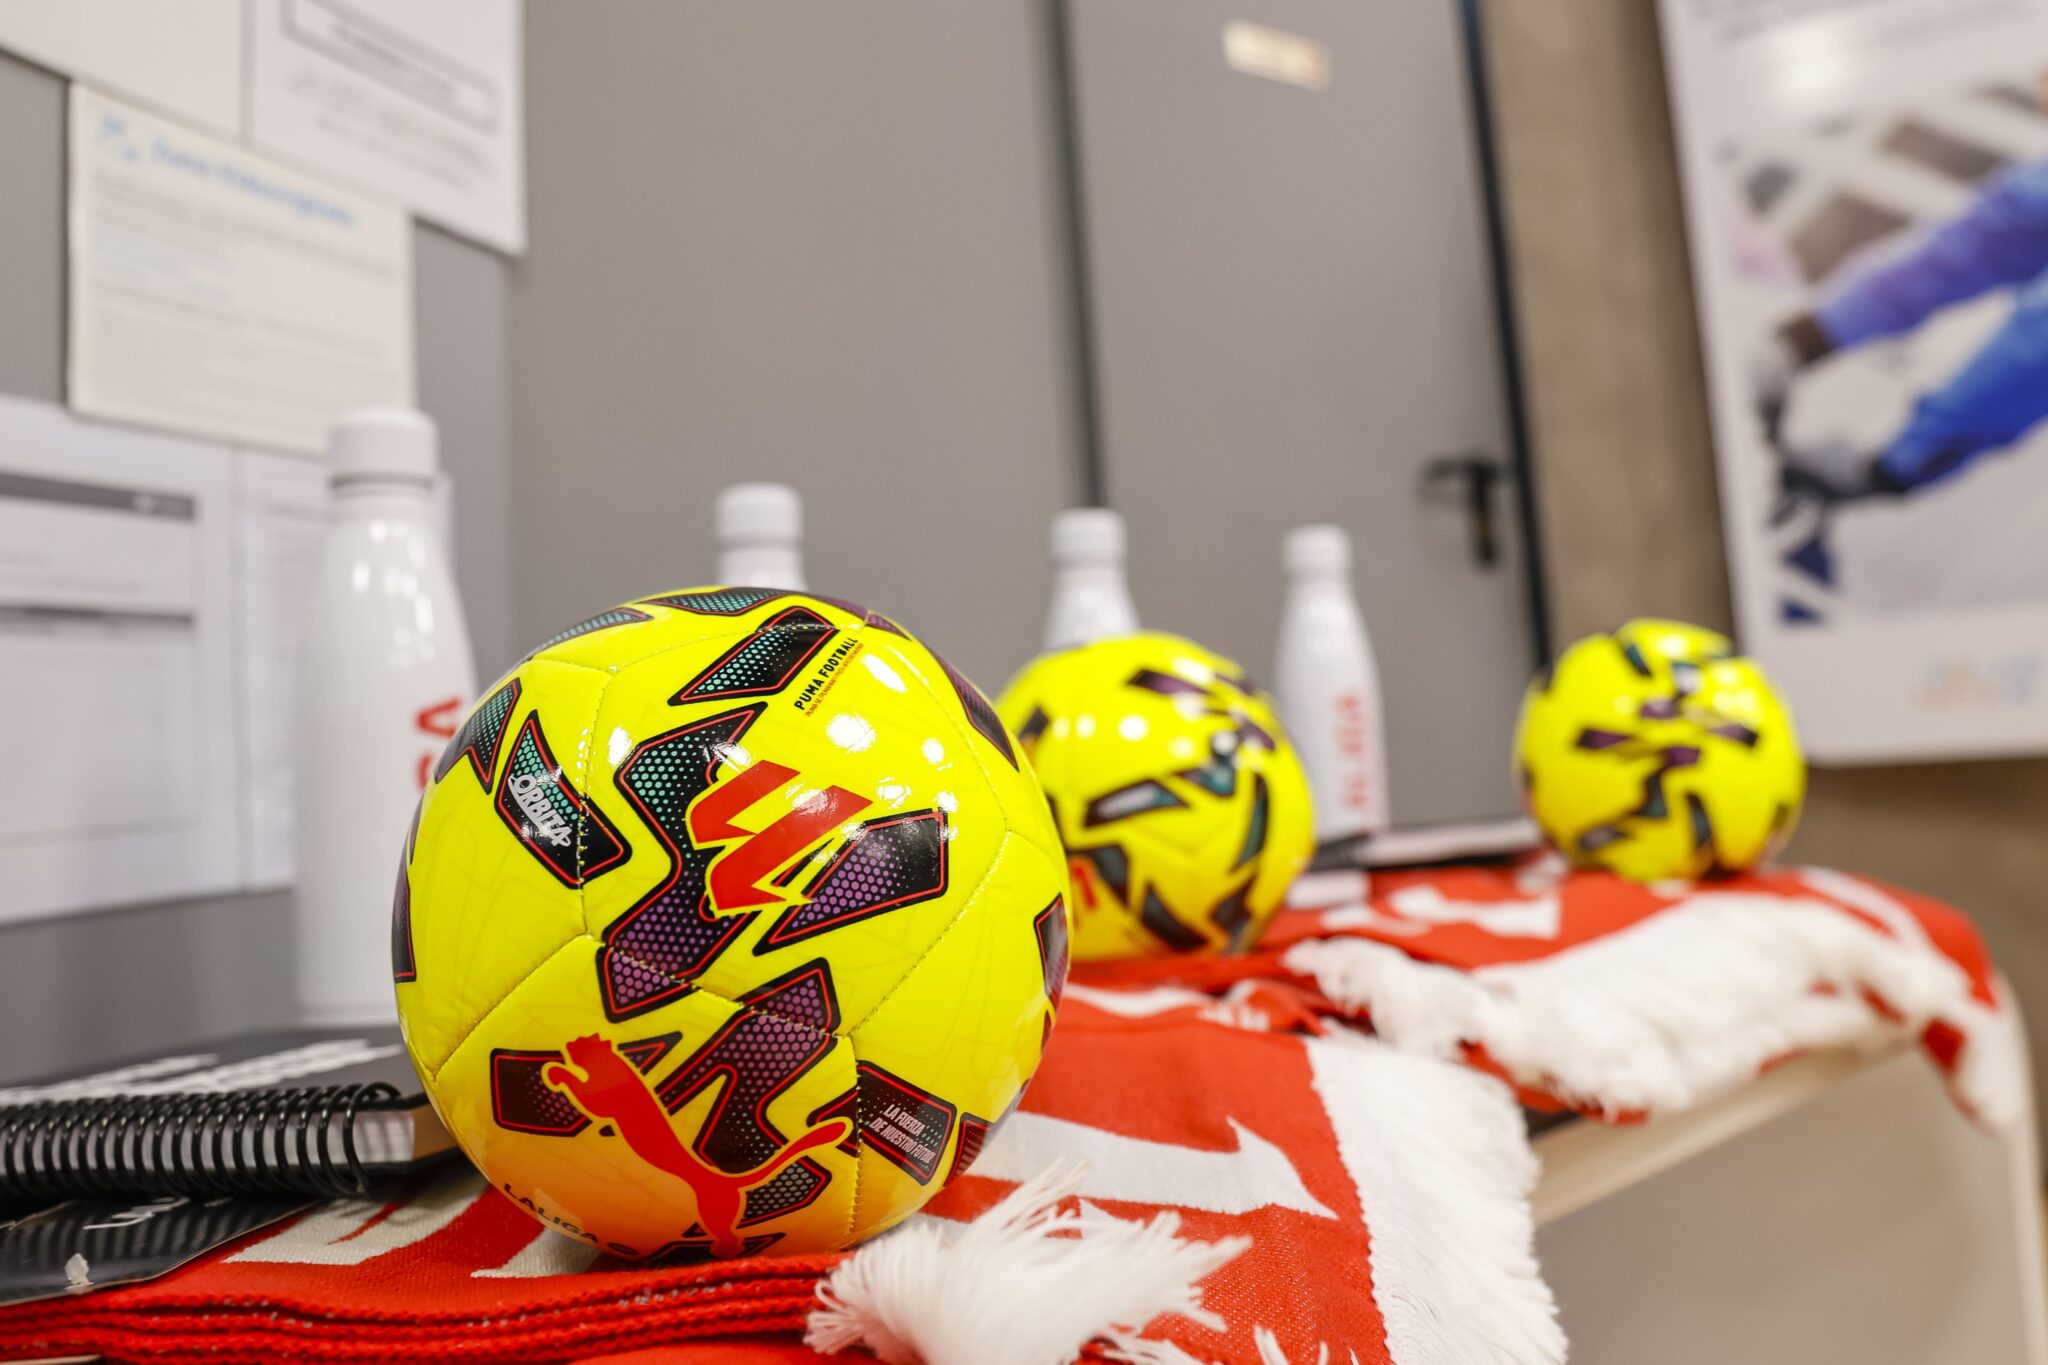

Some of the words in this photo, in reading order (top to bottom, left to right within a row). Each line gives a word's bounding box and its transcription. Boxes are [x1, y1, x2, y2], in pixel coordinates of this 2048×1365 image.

[793, 678, 825, 710] PUMA
[818, 637, 858, 678] FOOTBALL
[507, 773, 572, 847] ORBITA
[869, 1117, 888, 1133] DE
[880, 1124, 918, 1153] NUESTRO
[883, 1104, 901, 1120] LA
[894, 1111, 926, 1137] FUERZA
[503, 1183, 599, 1244] LALIGA
